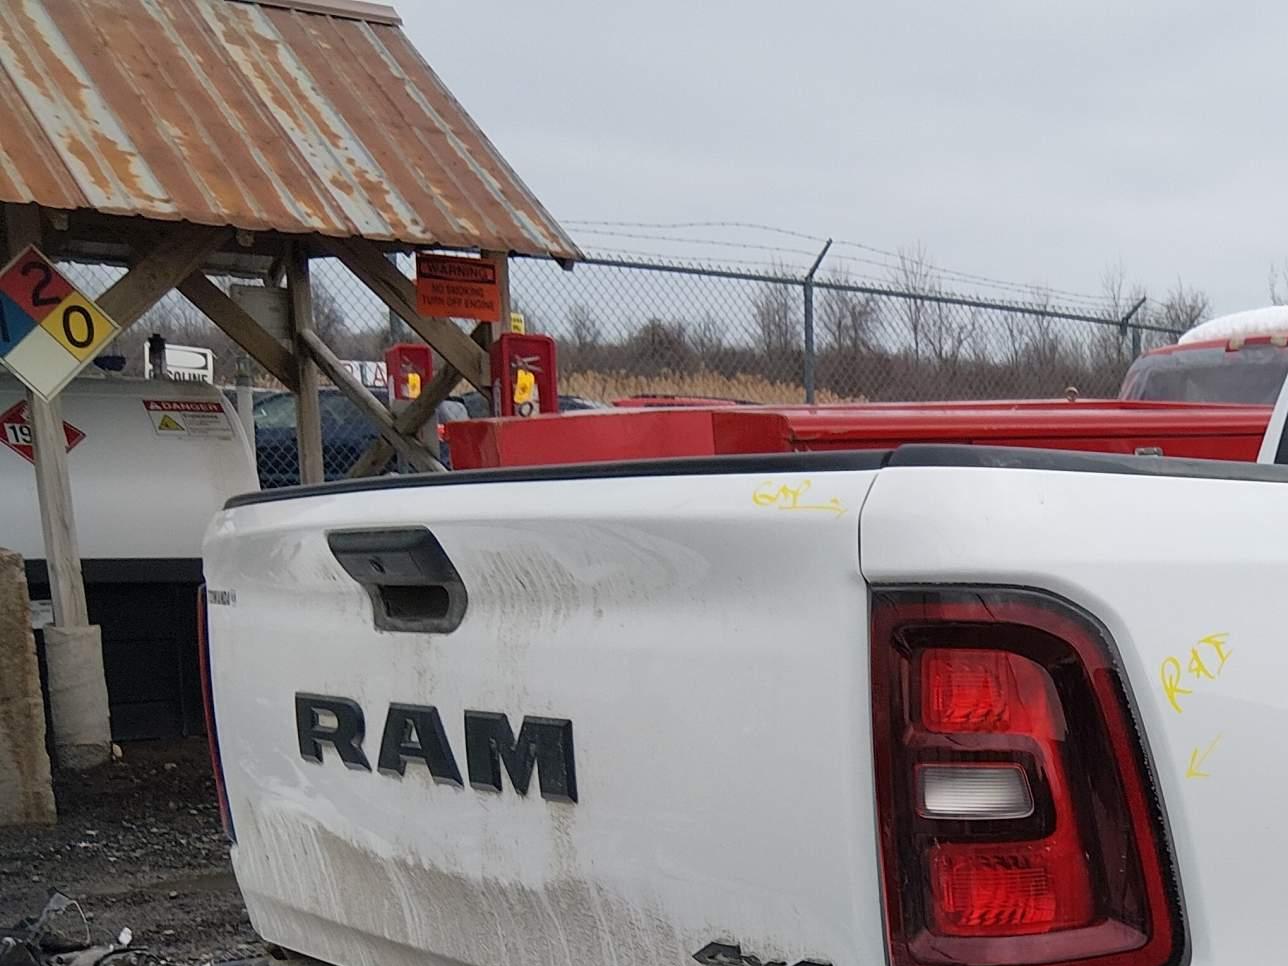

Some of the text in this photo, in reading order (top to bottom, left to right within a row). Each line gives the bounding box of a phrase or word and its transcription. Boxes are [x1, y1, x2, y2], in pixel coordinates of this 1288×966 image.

[20, 260, 63, 307] 2
[427, 261, 489, 280] WARNING
[62, 305, 95, 349] 0
[162, 402, 219, 411] DANGER
[295, 691, 579, 804] RAM
